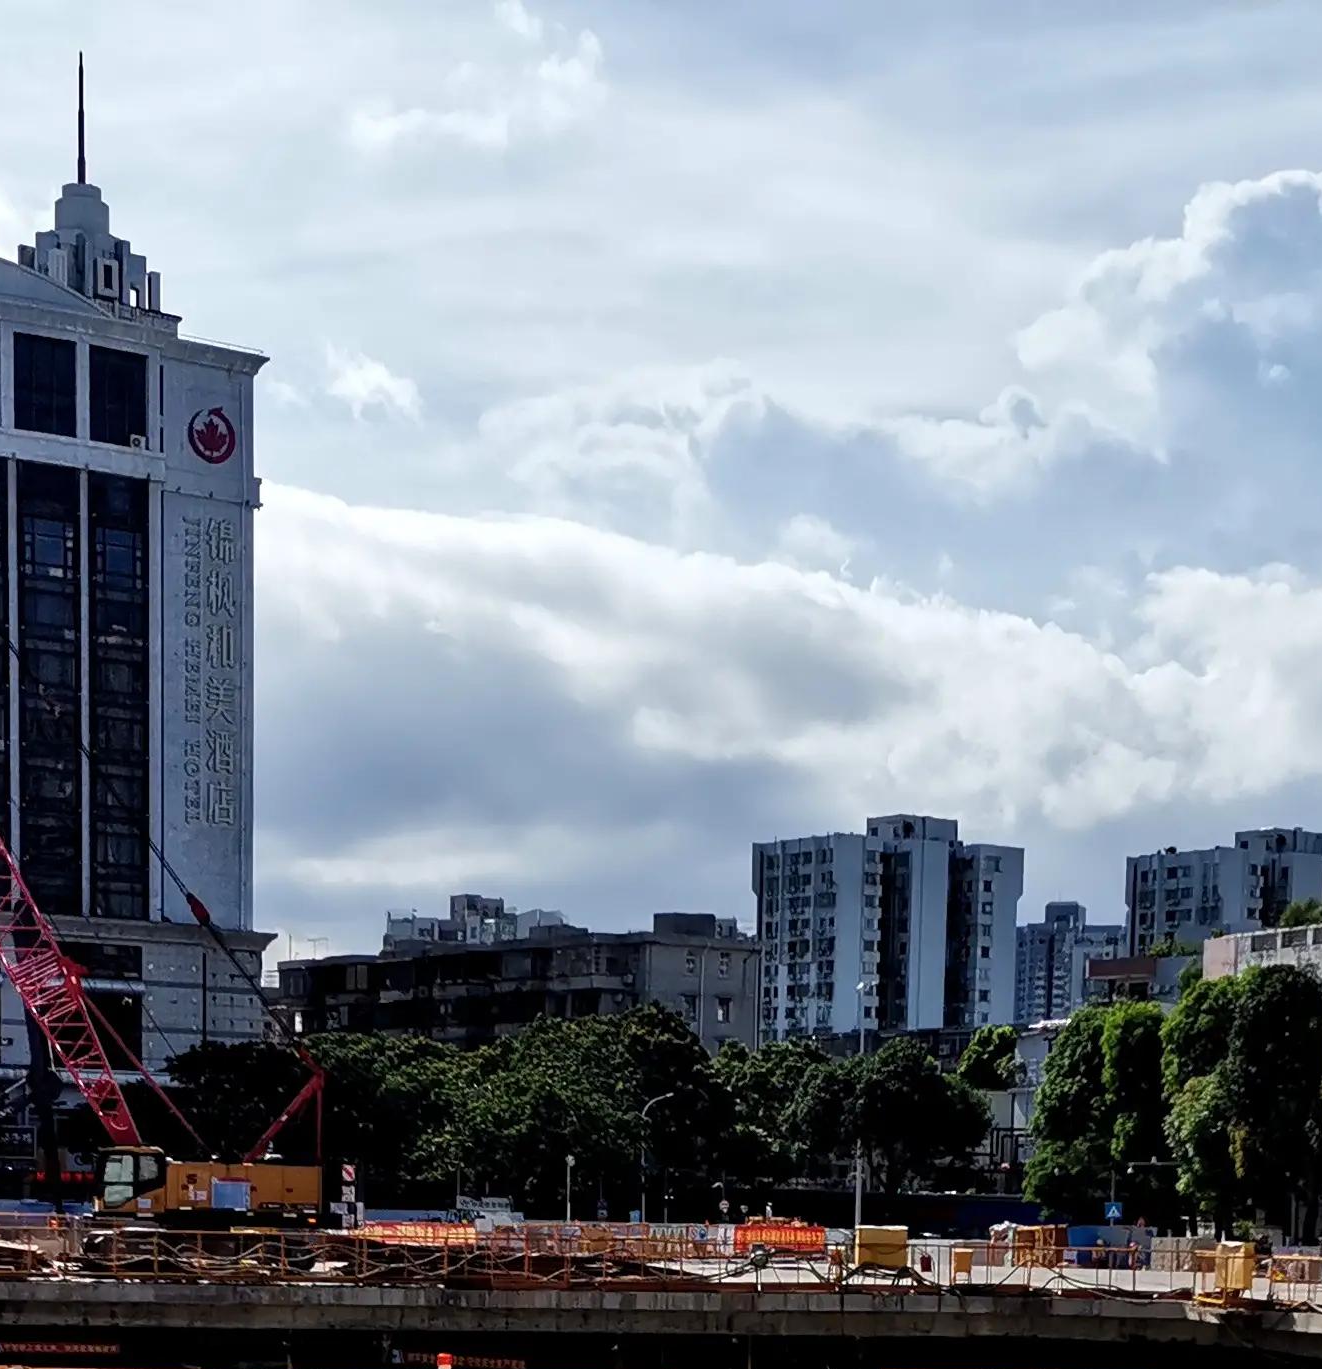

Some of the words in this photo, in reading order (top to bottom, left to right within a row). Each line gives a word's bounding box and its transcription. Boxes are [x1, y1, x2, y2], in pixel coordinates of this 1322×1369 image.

[205, 517, 237, 827] 锦枫和美酒店
